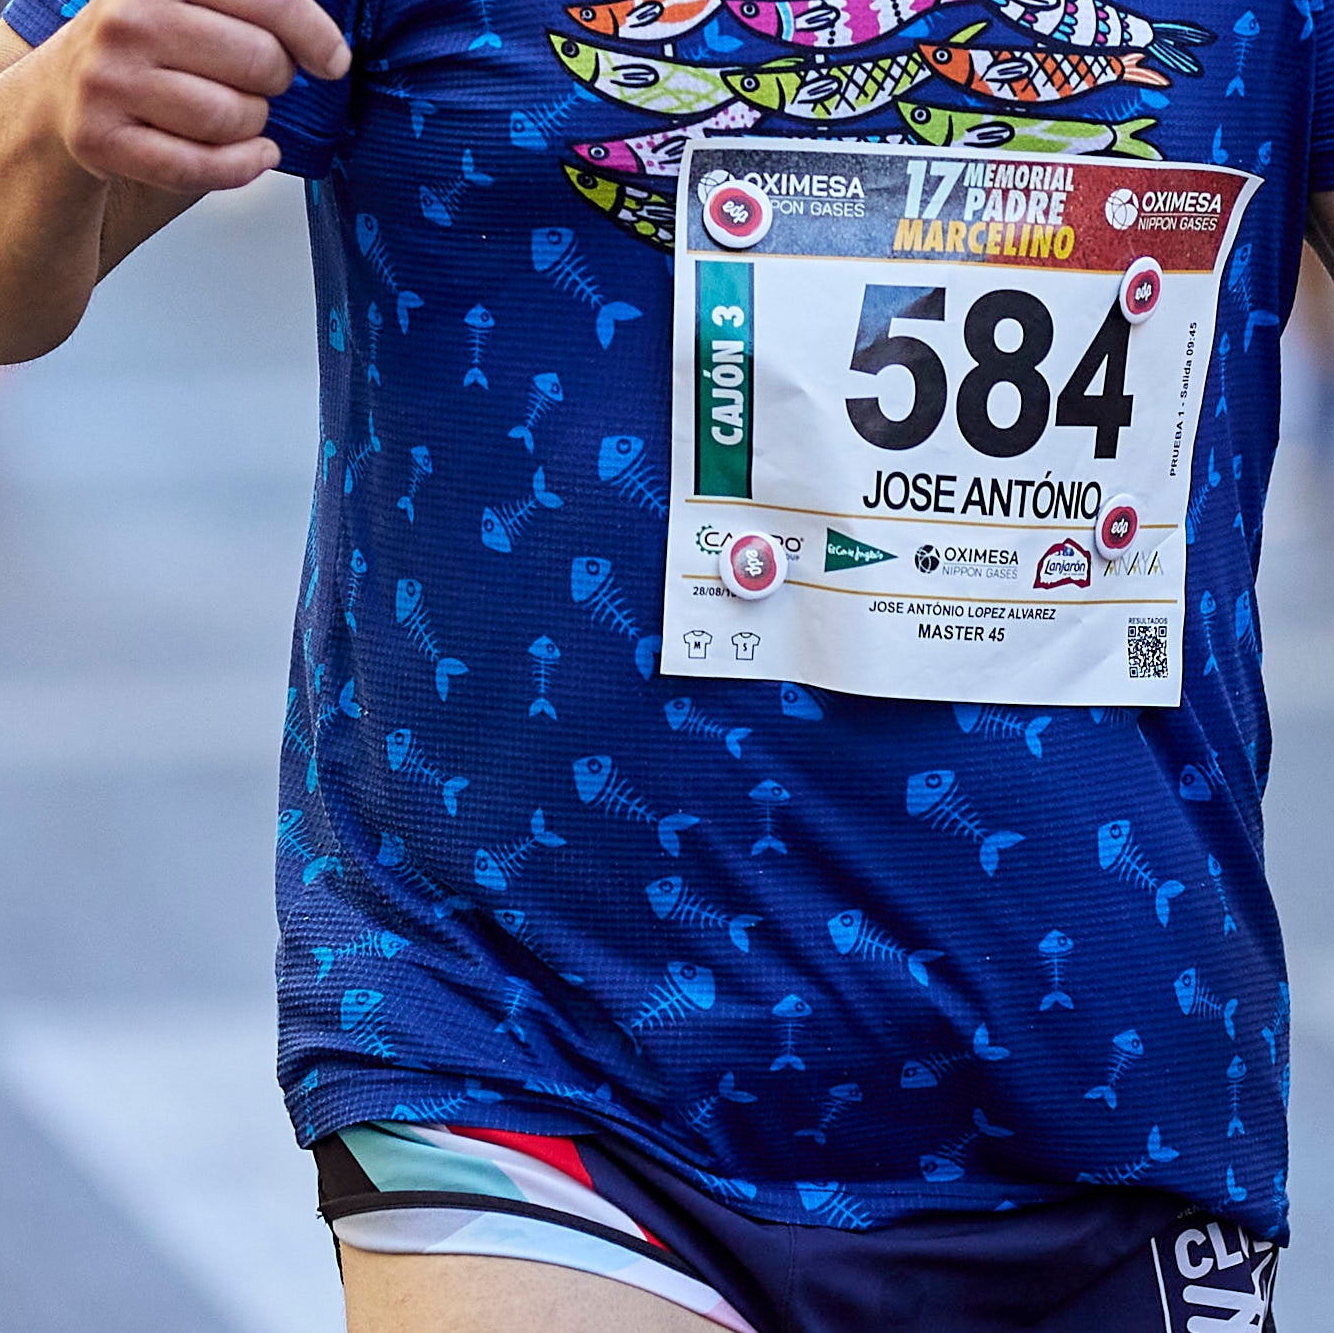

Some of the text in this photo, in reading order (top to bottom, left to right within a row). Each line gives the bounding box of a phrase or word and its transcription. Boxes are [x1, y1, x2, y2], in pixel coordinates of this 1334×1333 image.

[904, 160, 1074, 219] 17 MEMORIAL
[810, 202, 865, 218] GASES
[963, 188, 1067, 225] PADRE
[1141, 191, 1222, 213] OXIMESA
[1137, 216, 1218, 232] NIPPON GASES
[893, 219, 1075, 260] MARCELINO
[703, 305, 745, 446] CAJÓN 3
[845, 283, 1134, 459] 584
[1169, 420, 1184, 477] PRUEBA
[1180, 359, 1193, 399] Salida
[862, 470, 1103, 519] JOSE ANTÓNIO
[944, 547, 1018, 566] OXIMESA
[1044, 559, 1086, 575] Lanjarón
[942, 566, 1018, 580] NIPPON GASES
[868, 600, 1057, 621] JOSE ANTÓNIO LOPEZ ALVAREZ
[1128, 617, 1168, 625] RESULTADOS
[918, 623, 1006, 642] MASTER 45
